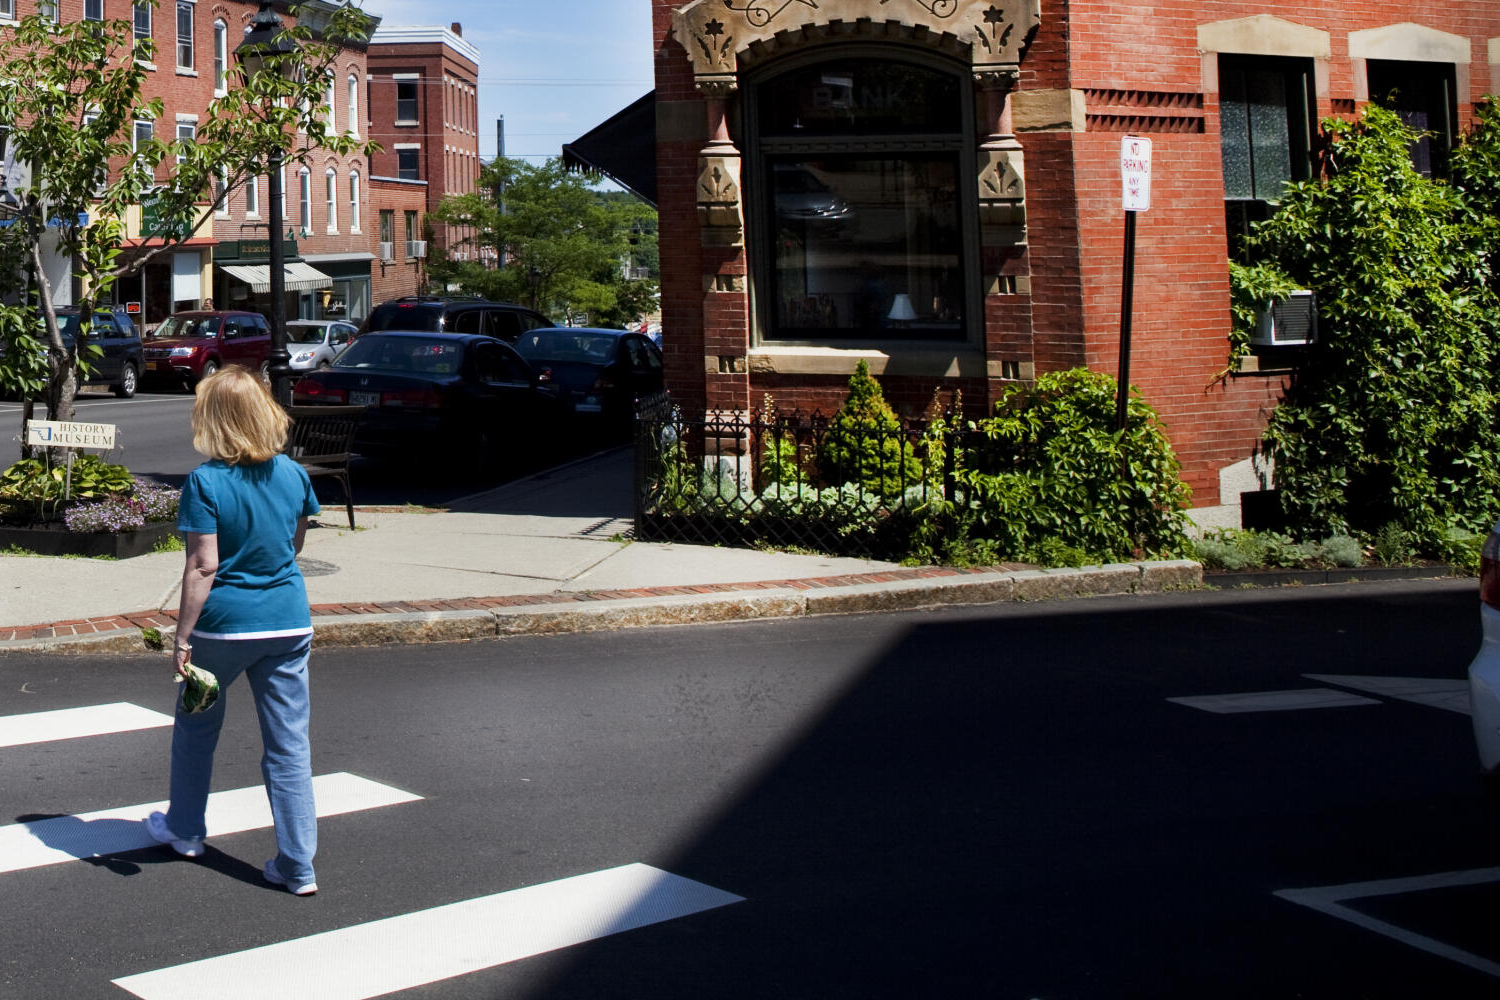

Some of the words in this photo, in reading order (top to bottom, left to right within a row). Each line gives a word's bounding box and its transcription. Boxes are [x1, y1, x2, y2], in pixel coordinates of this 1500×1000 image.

[1131, 144, 1140, 156] NO
[1123, 159, 1148, 173] PARKING
[1129, 177, 1140, 186] ANY
[149, 222, 184, 235] Catrig
[60, 423, 106, 434] HISTORY
[53, 433, 112, 445] MUSEUM
